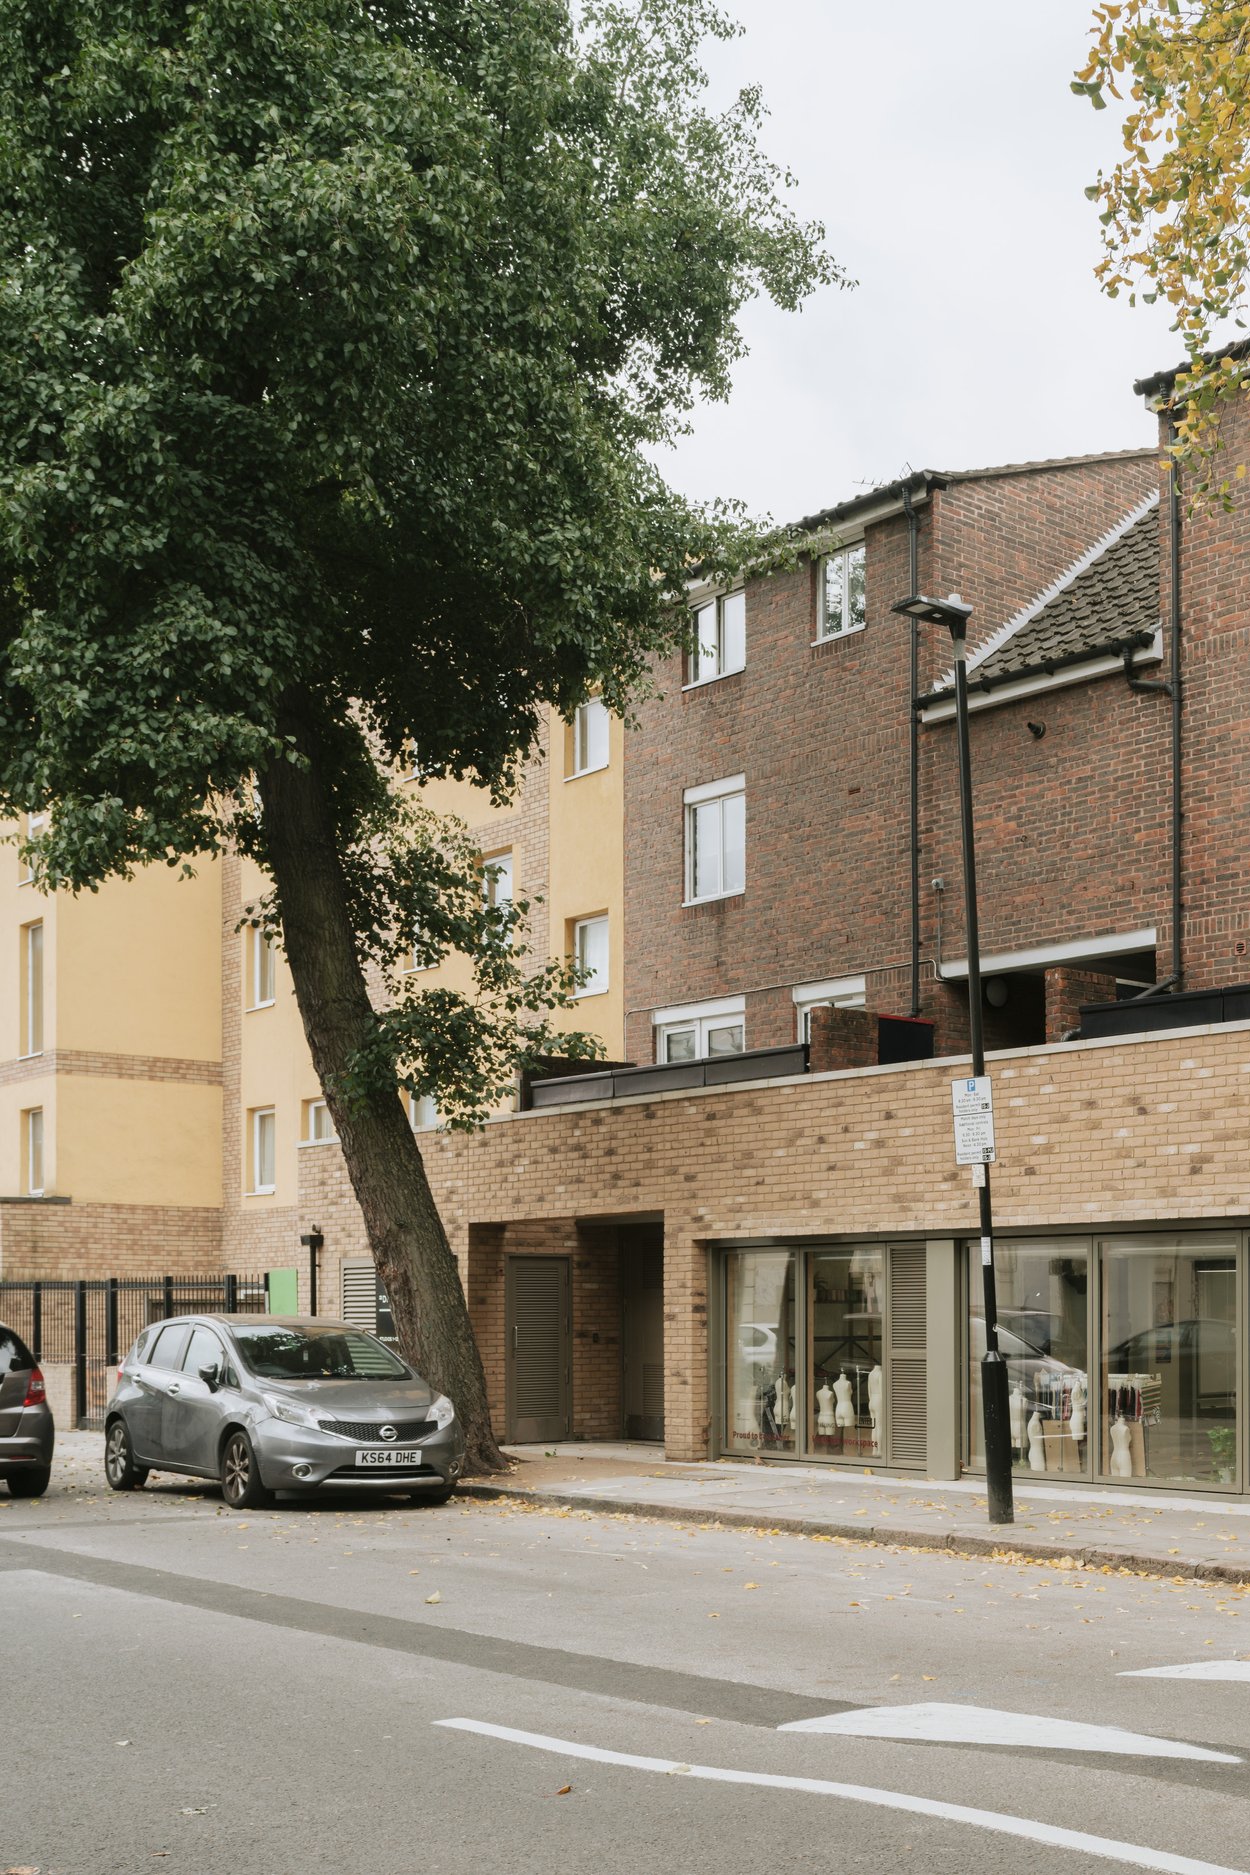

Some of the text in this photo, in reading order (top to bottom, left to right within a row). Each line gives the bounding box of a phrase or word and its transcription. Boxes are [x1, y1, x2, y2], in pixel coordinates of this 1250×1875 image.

[732, 1430, 750, 1439] Proud
[751, 1432, 758, 1440] to
[361, 1452, 416, 1464] KS64 DHE
